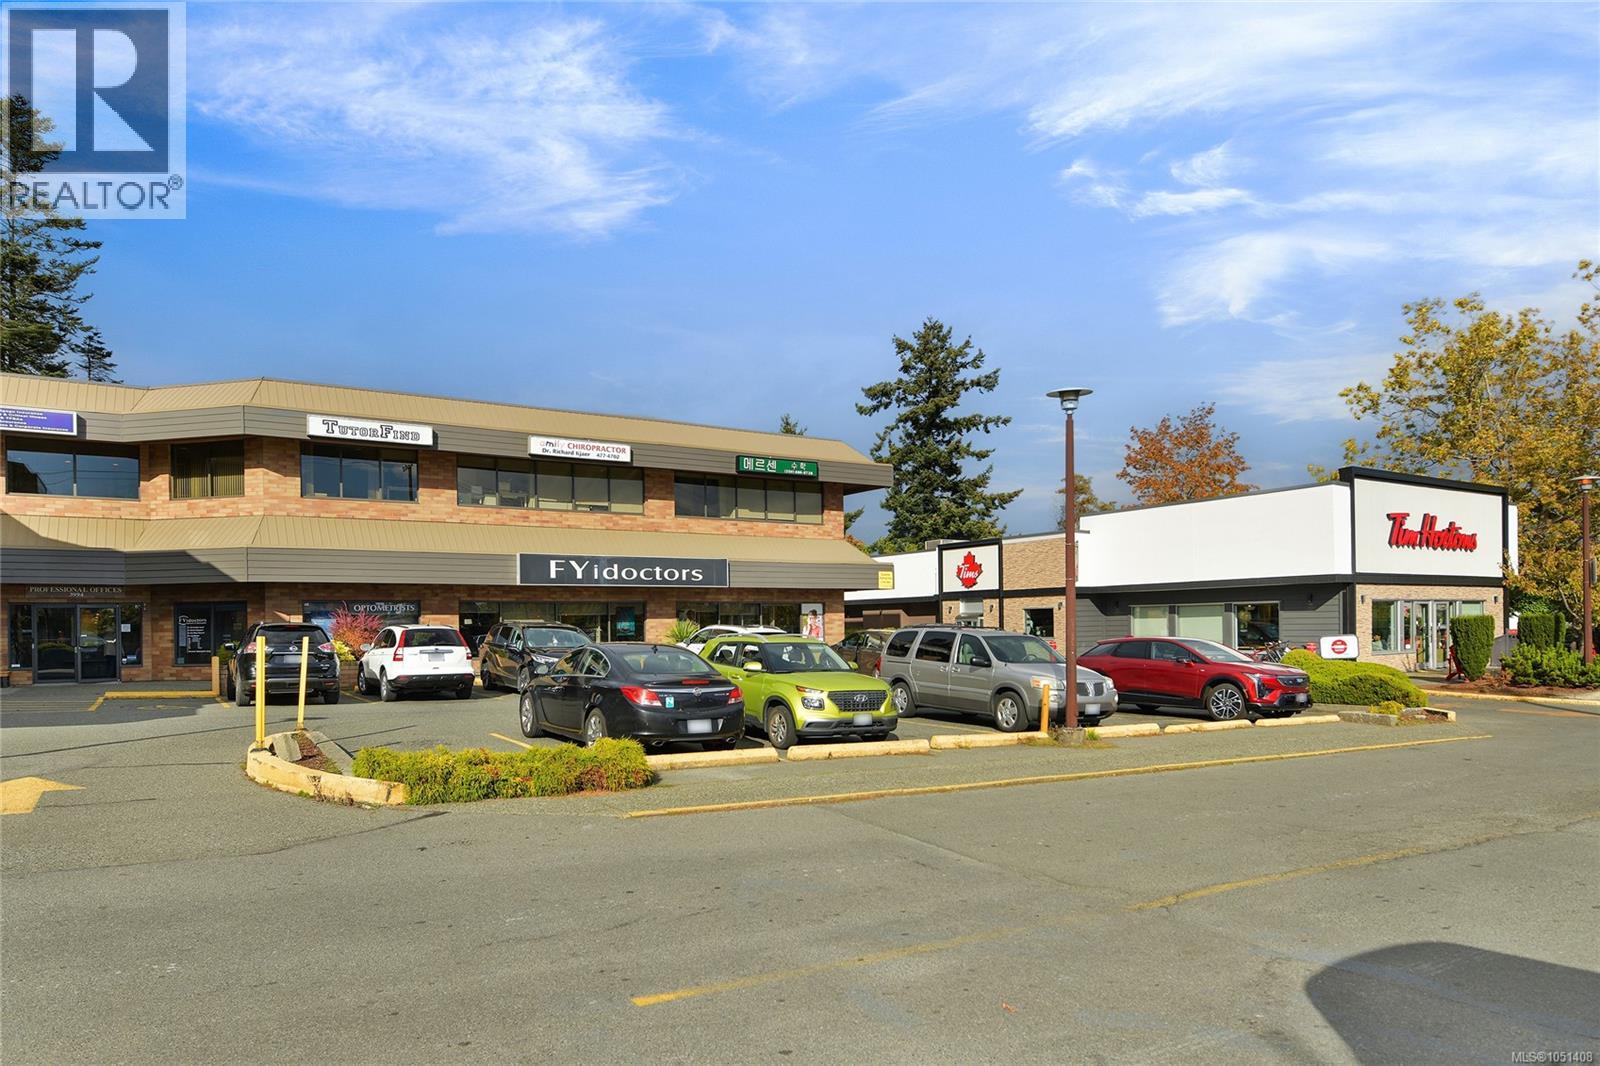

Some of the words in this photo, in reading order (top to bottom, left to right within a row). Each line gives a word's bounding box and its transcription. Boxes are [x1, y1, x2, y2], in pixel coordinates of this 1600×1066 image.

[552, 448, 575, 456] Richard
[567, 442, 626, 454] CHIROPRACTOR
[743, 457, 777, 473] 메르센
[1386, 513, 1419, 549] Tim
[1420, 513, 1478, 552] Hortons
[960, 564, 979, 579] Tims
[353, 602, 415, 612] OPTOMETRISTS
